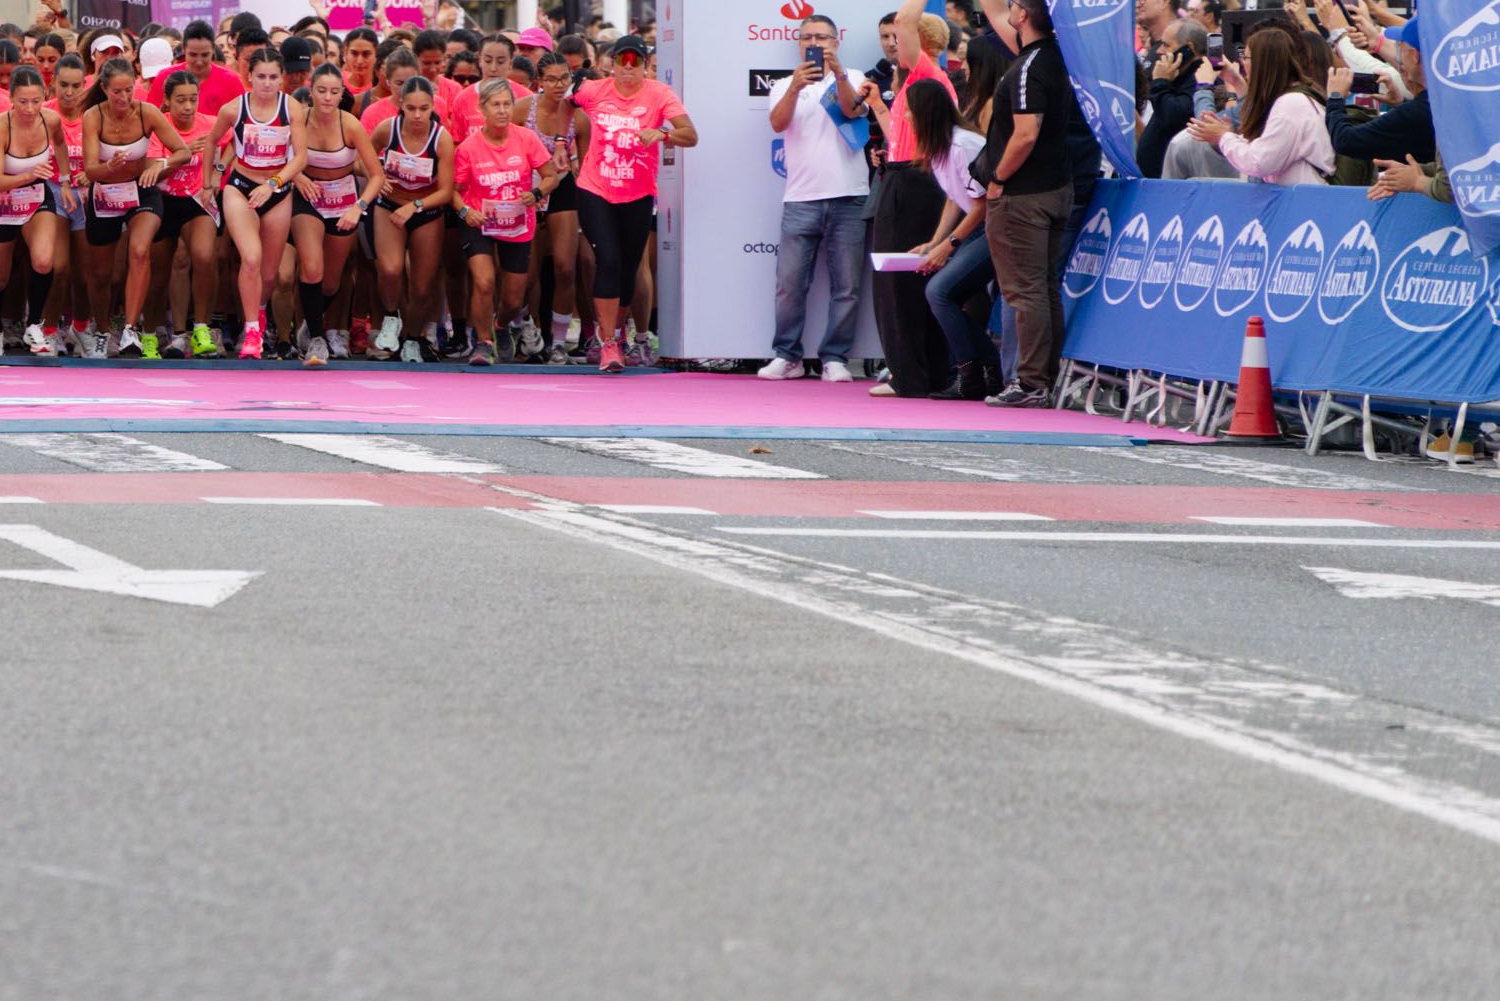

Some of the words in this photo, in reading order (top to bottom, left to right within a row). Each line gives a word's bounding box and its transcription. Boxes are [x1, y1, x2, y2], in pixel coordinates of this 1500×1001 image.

[257, 145, 276, 154] 016
[478, 170, 520, 187] CARRERA
[324, 195, 343, 205] 016
[12, 203, 30, 212] 016
[1387, 262, 1477, 307] ASTURIANA
